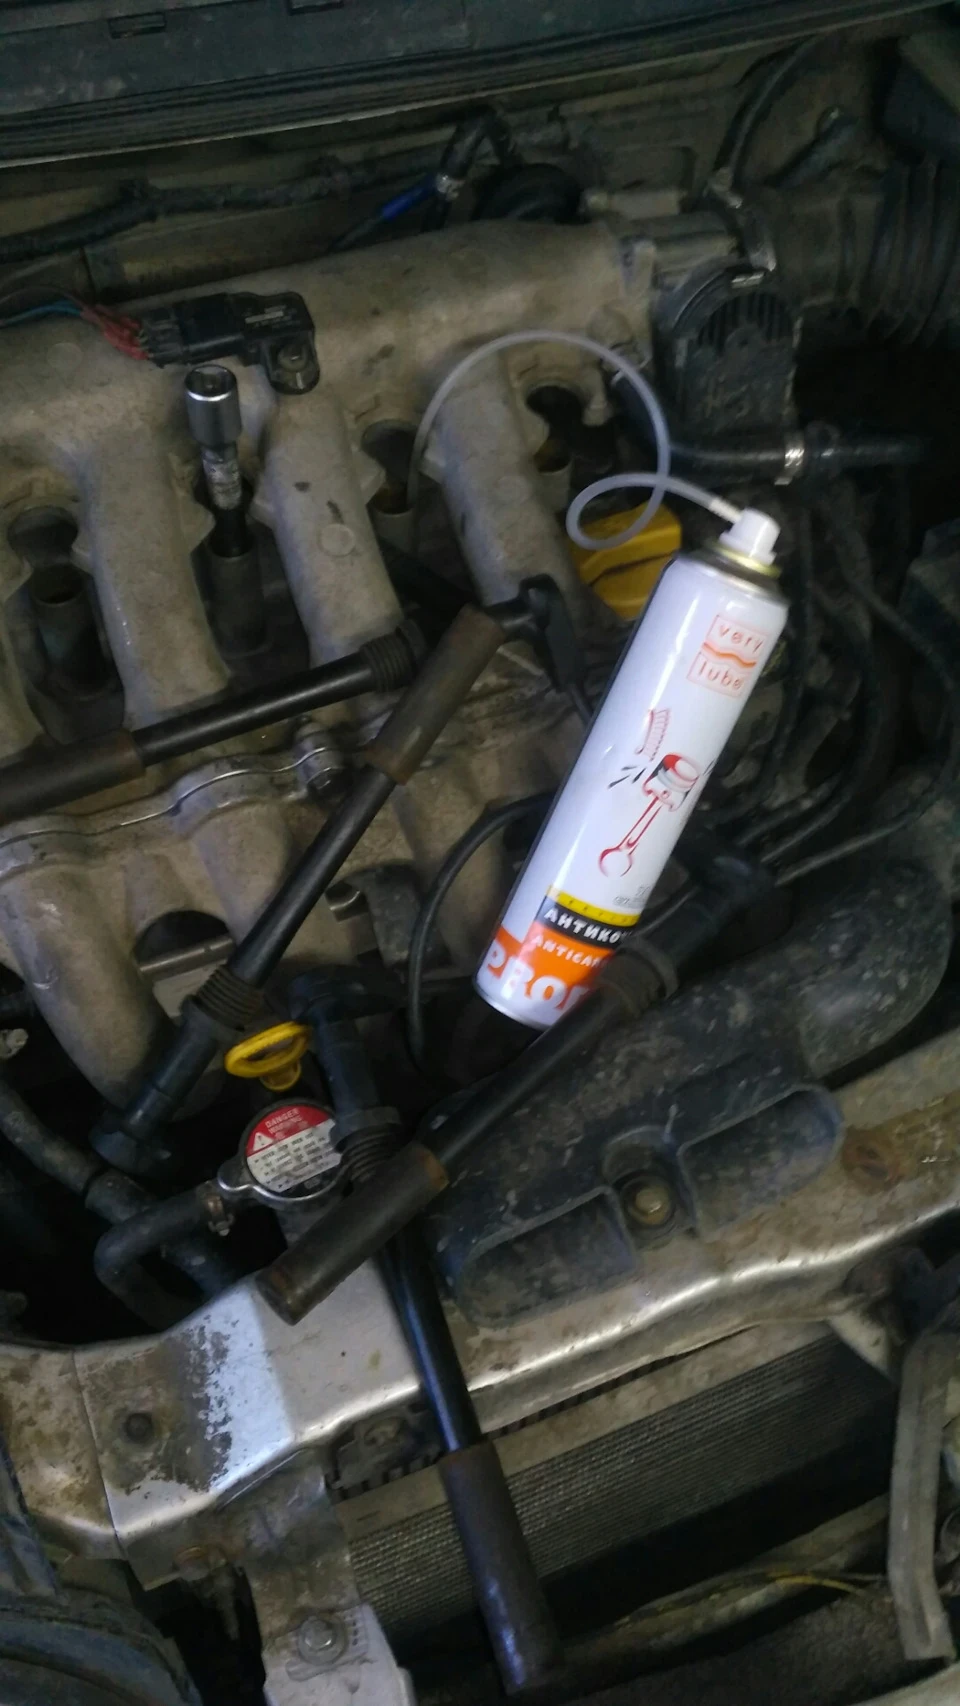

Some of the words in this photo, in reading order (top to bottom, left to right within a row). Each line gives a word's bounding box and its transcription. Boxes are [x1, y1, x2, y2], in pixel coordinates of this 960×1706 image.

[719, 624, 764, 653] very
[698, 660, 744, 690] lube
[544, 907, 632, 944] АНТИКО
[532, 934, 607, 968] ANTICAR
[265, 1107, 300, 1129] DANGER
